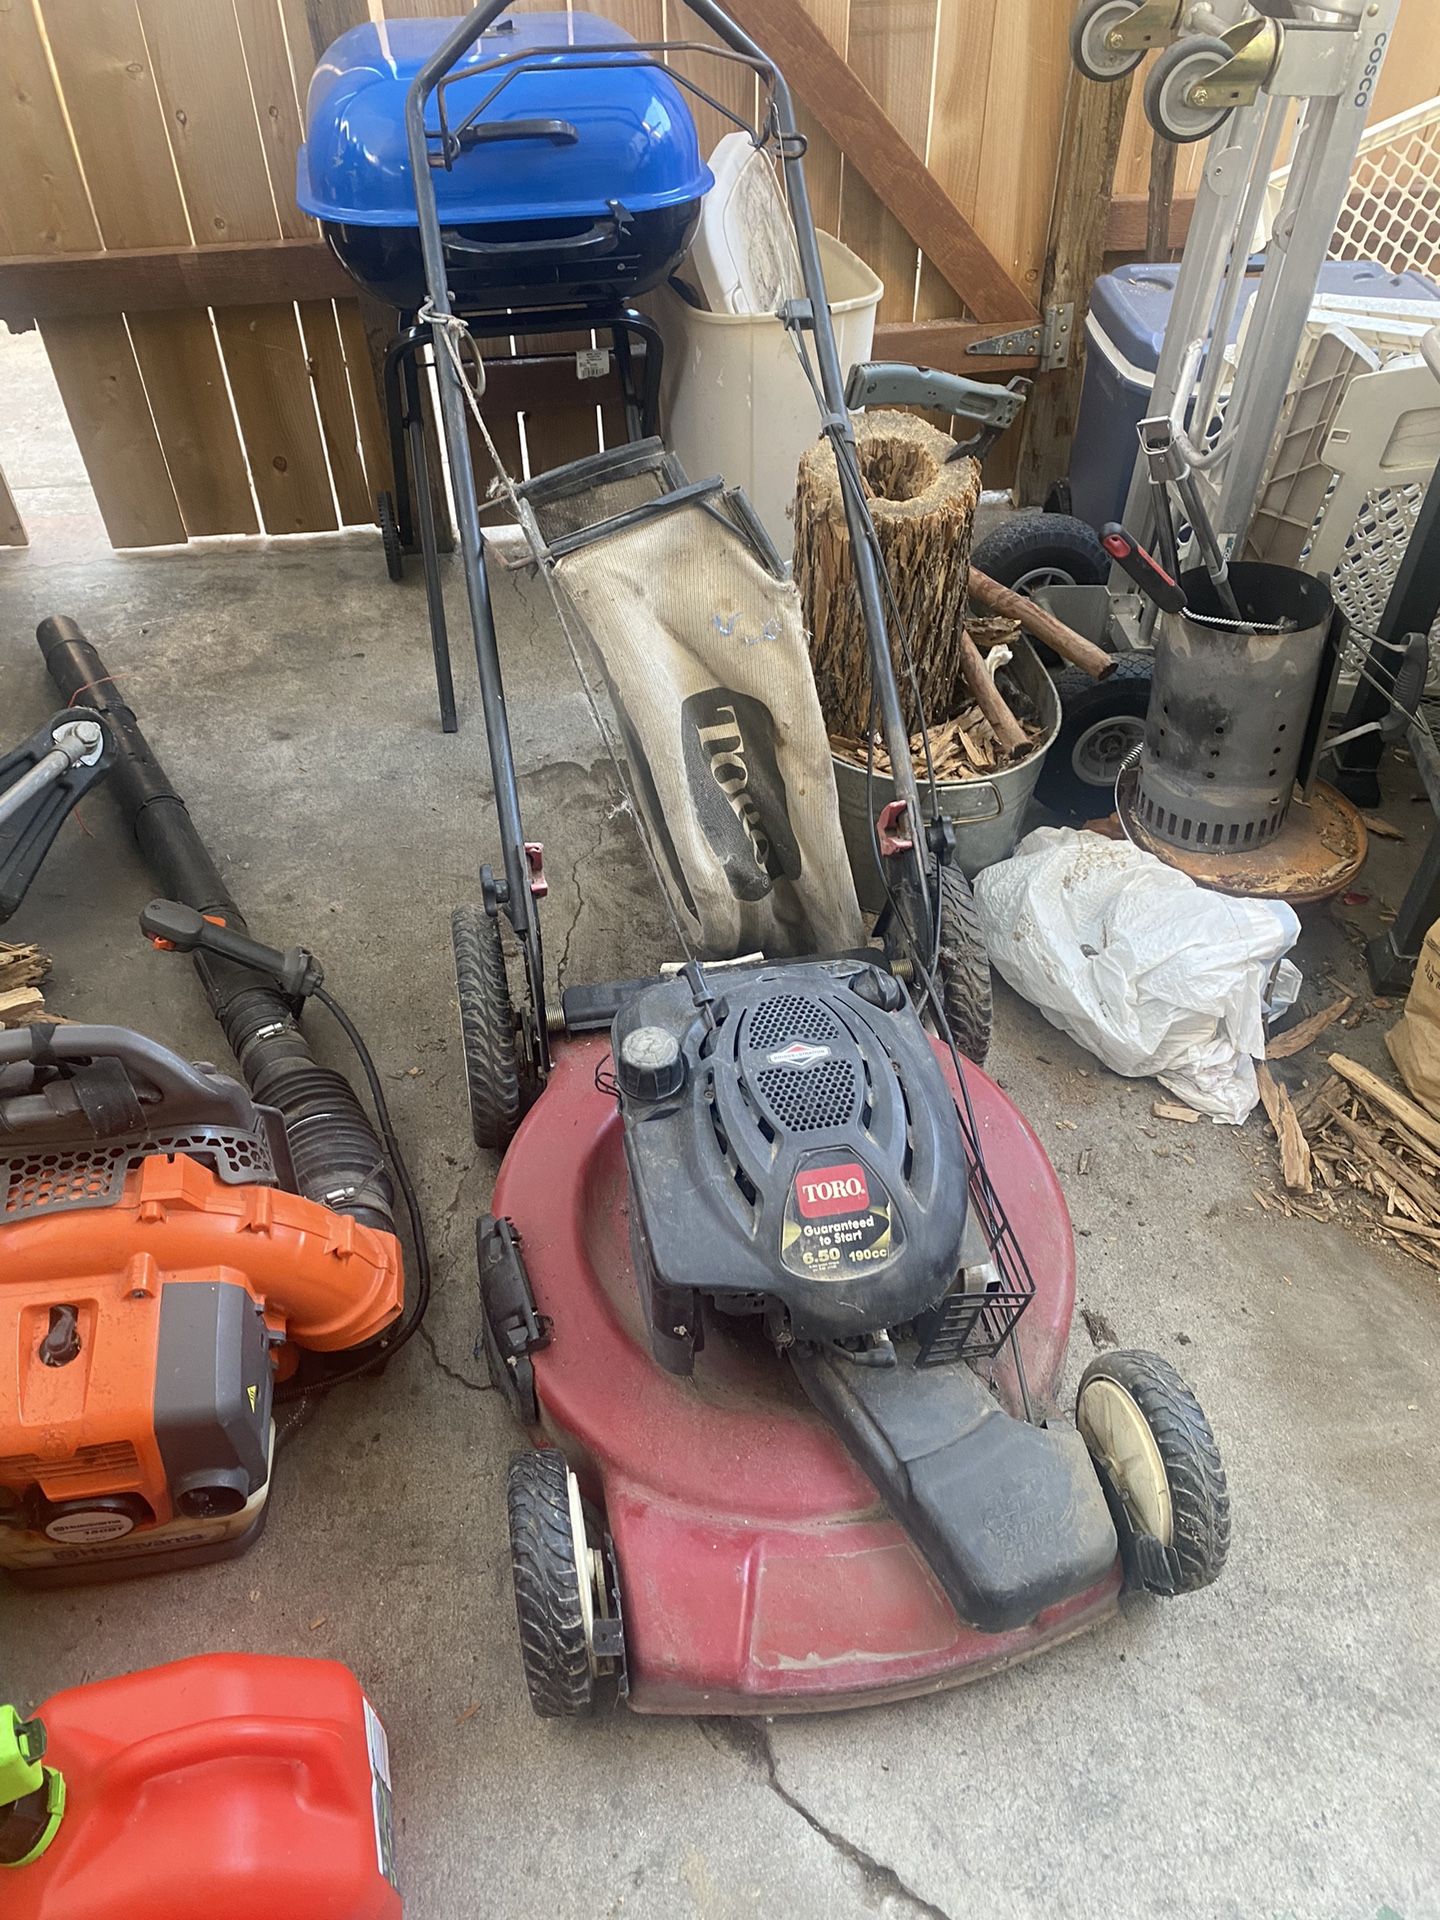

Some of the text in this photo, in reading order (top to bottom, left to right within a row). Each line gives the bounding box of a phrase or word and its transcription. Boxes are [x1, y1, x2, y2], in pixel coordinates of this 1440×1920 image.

[1354, 32, 1387, 108] COSCO
[802, 1177, 865, 1203] TORO
[803, 1215, 875, 1237] Guaranteed
[819, 1230, 863, 1246] to Start
[802, 1247, 888, 1265] 6.50 190cc
